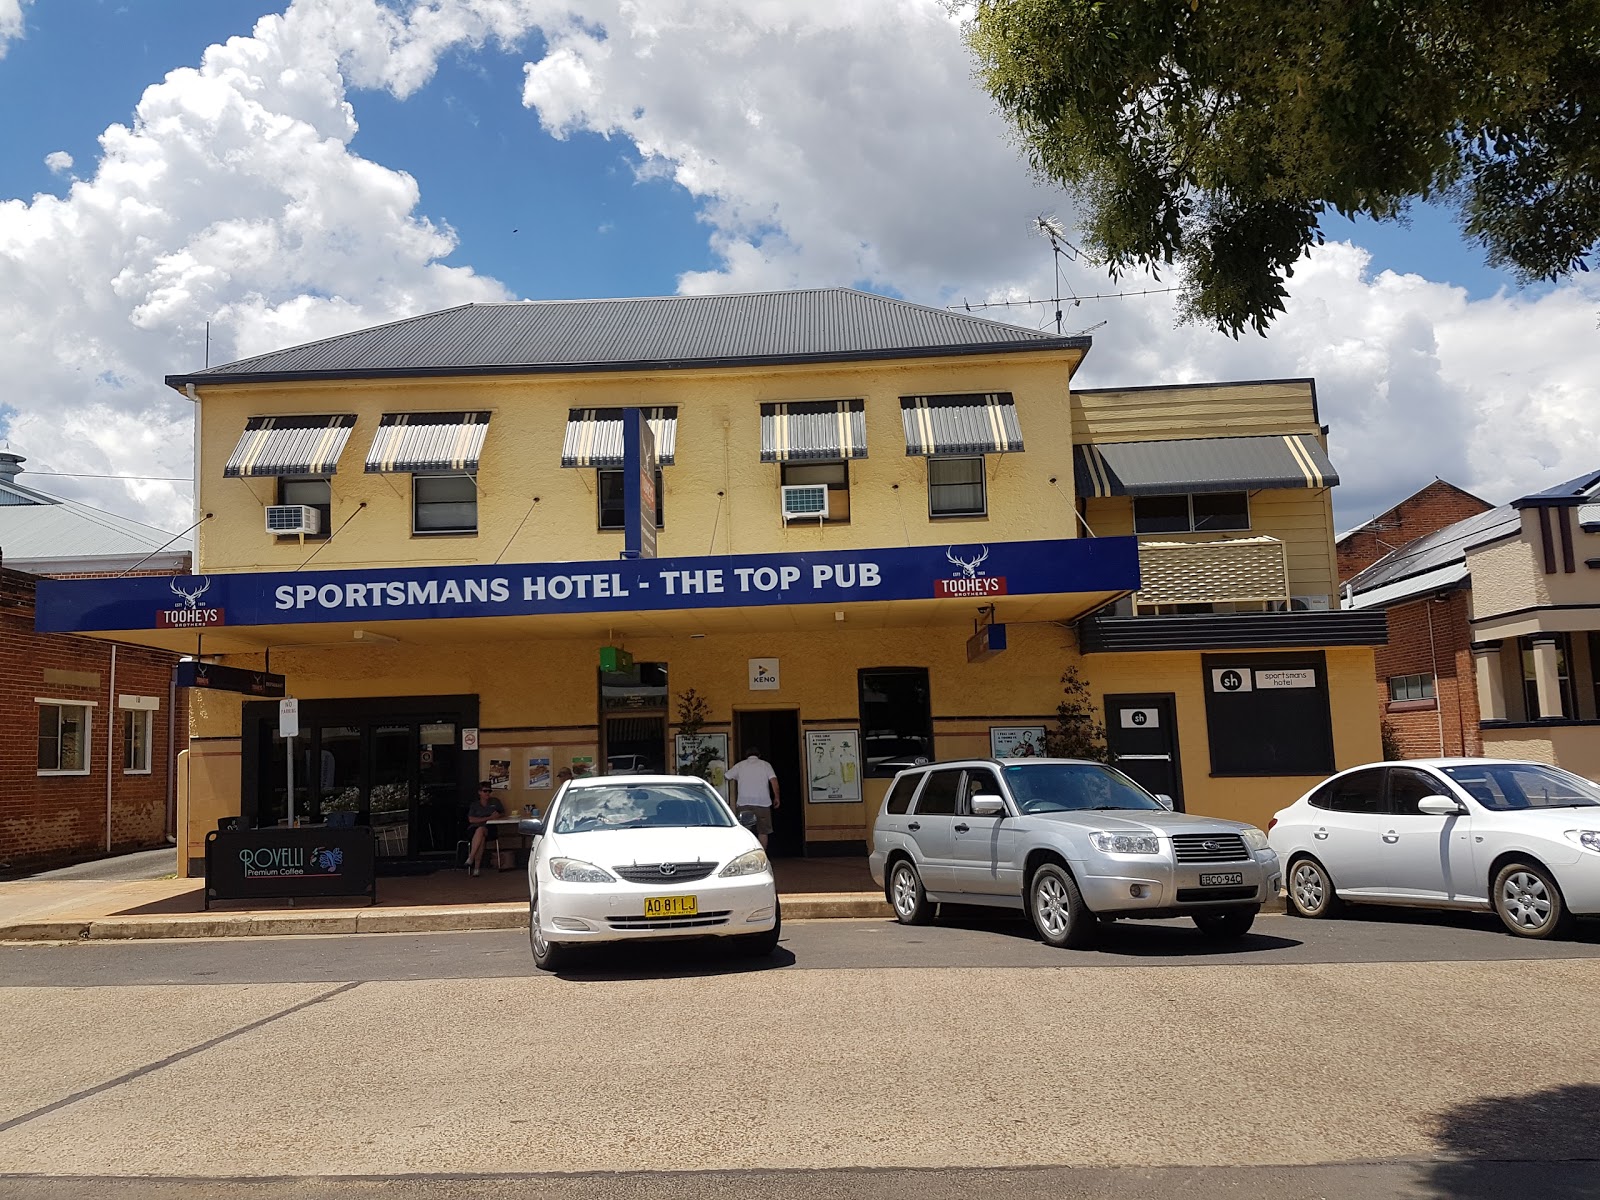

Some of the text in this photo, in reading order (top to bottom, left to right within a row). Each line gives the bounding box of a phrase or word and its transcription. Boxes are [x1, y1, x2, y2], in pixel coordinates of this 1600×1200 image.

[275, 578, 510, 610] SPORTSMANS
[523, 573, 629, 601] HOTEL
[659, 569, 724, 595] THE
[734, 566, 801, 592] TOP
[812, 563, 882, 589] PUB
[941, 577, 999, 593] TOOHEYS
[163, 608, 218, 624] TOOHEYS
[1223, 673, 1239, 687] sh
[1264, 672, 1307, 680] sportsmans
[1134, 713, 1145, 723] sh
[239, 847, 304, 878] ROVELLI
[279, 867, 304, 875] Coffee
